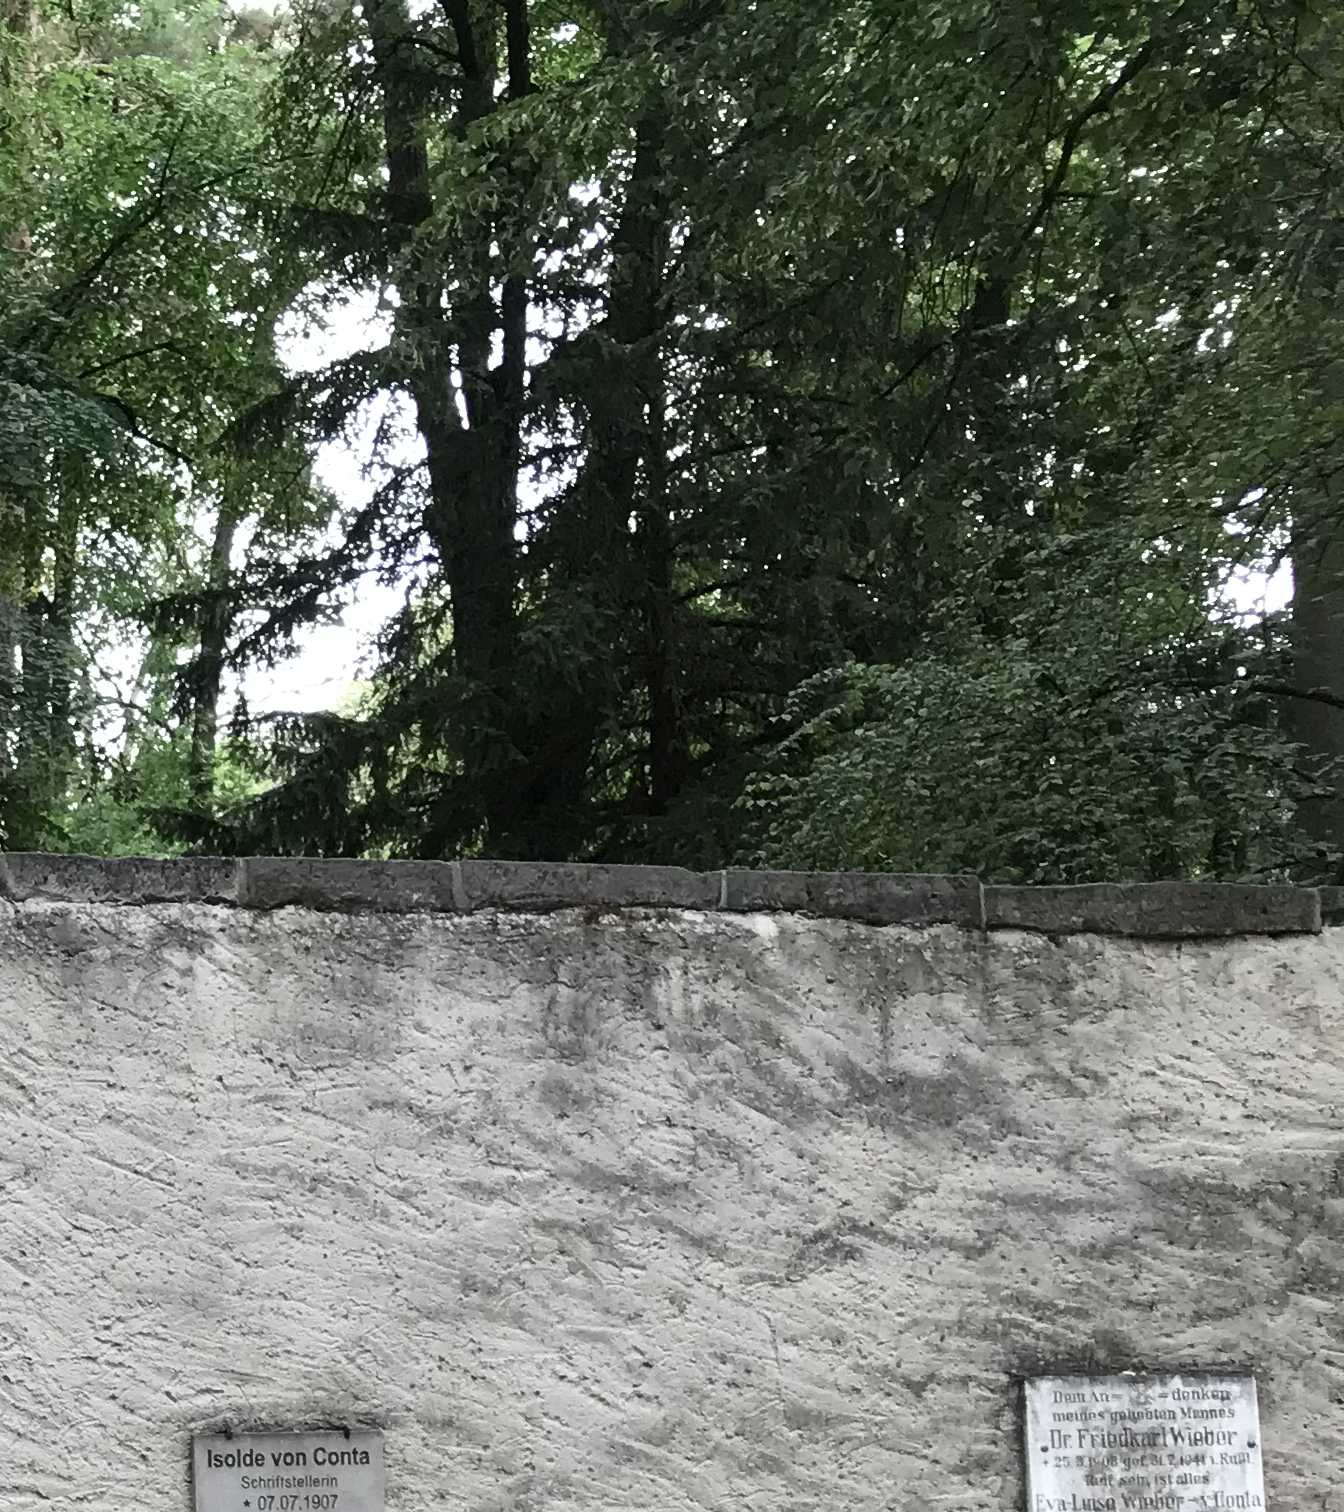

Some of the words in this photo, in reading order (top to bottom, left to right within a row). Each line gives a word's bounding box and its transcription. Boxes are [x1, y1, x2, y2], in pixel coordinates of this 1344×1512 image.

[1052, 1409, 1106, 1422] meines
[1110, 1407, 1177, 1425] geliebten
[1179, 1406, 1236, 1420] Mannes
[1169, 1425, 1238, 1448] Wieber
[207, 1448, 266, 1469] Isolde
[270, 1452, 307, 1467] von
[313, 1446, 371, 1467] Conta
[240, 1474, 339, 1490] Schriftstellerin
[256, 1494, 339, 1511] 07.07.1907
[1213, 1490, 1263, 1509] Conta
